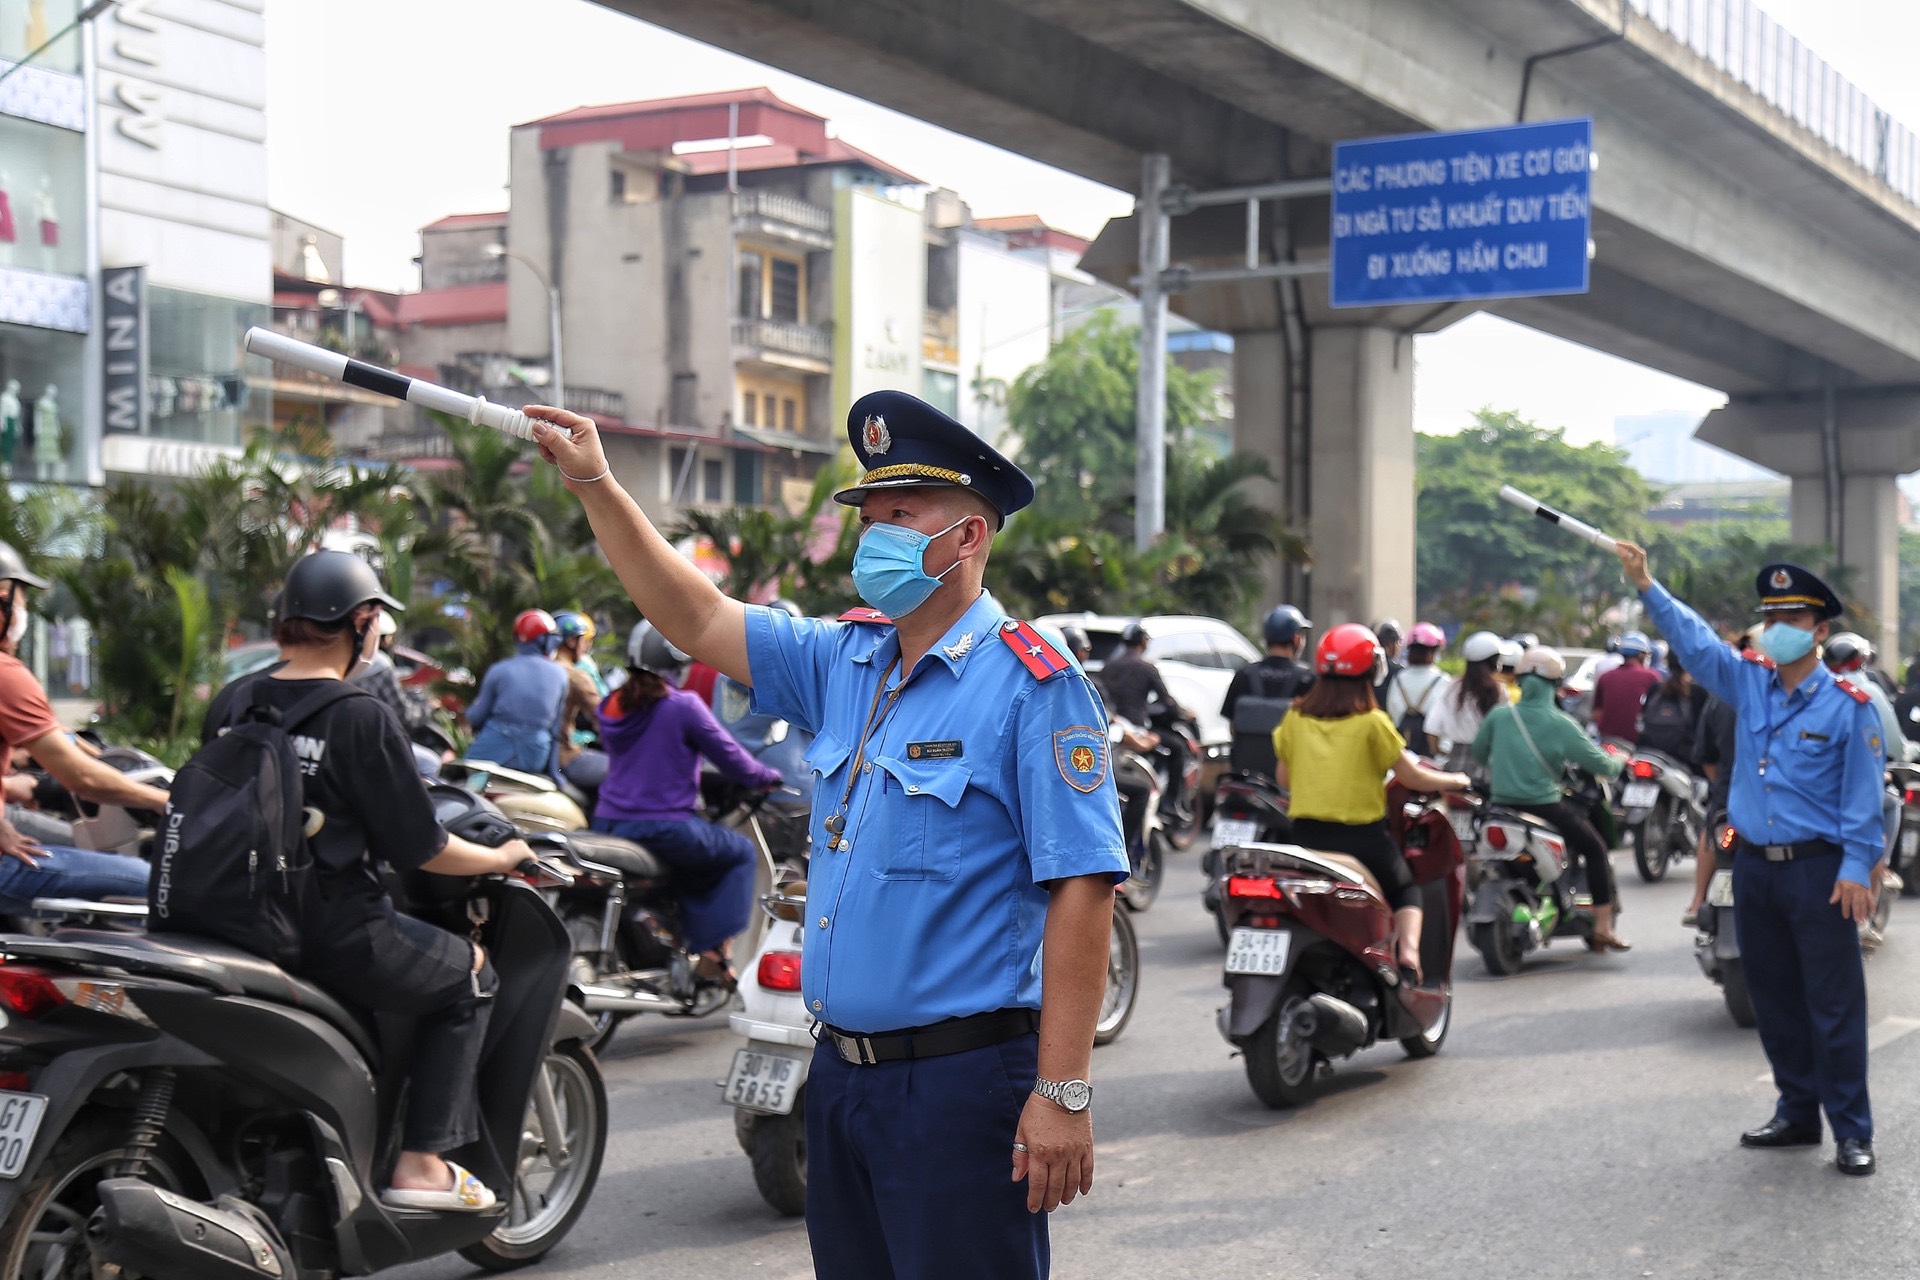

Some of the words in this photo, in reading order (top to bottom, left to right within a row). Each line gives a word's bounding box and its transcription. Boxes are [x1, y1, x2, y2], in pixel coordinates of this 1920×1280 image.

[1334, 161, 1371, 193] CÁC
[1374, 159, 1446, 191] PHƯƠNG
[1450, 151, 1492, 185] TIỆN
[1495, 151, 1521, 179] XE
[1506, 196, 1544, 224] DUY
[1367, 253, 1386, 280] ĐI
[1391, 241, 1451, 278] XUỐNG
[1504, 241, 1547, 270] CHUI
[106, 269, 138, 430] MINA
[732, 1078, 786, 1107] 5855
